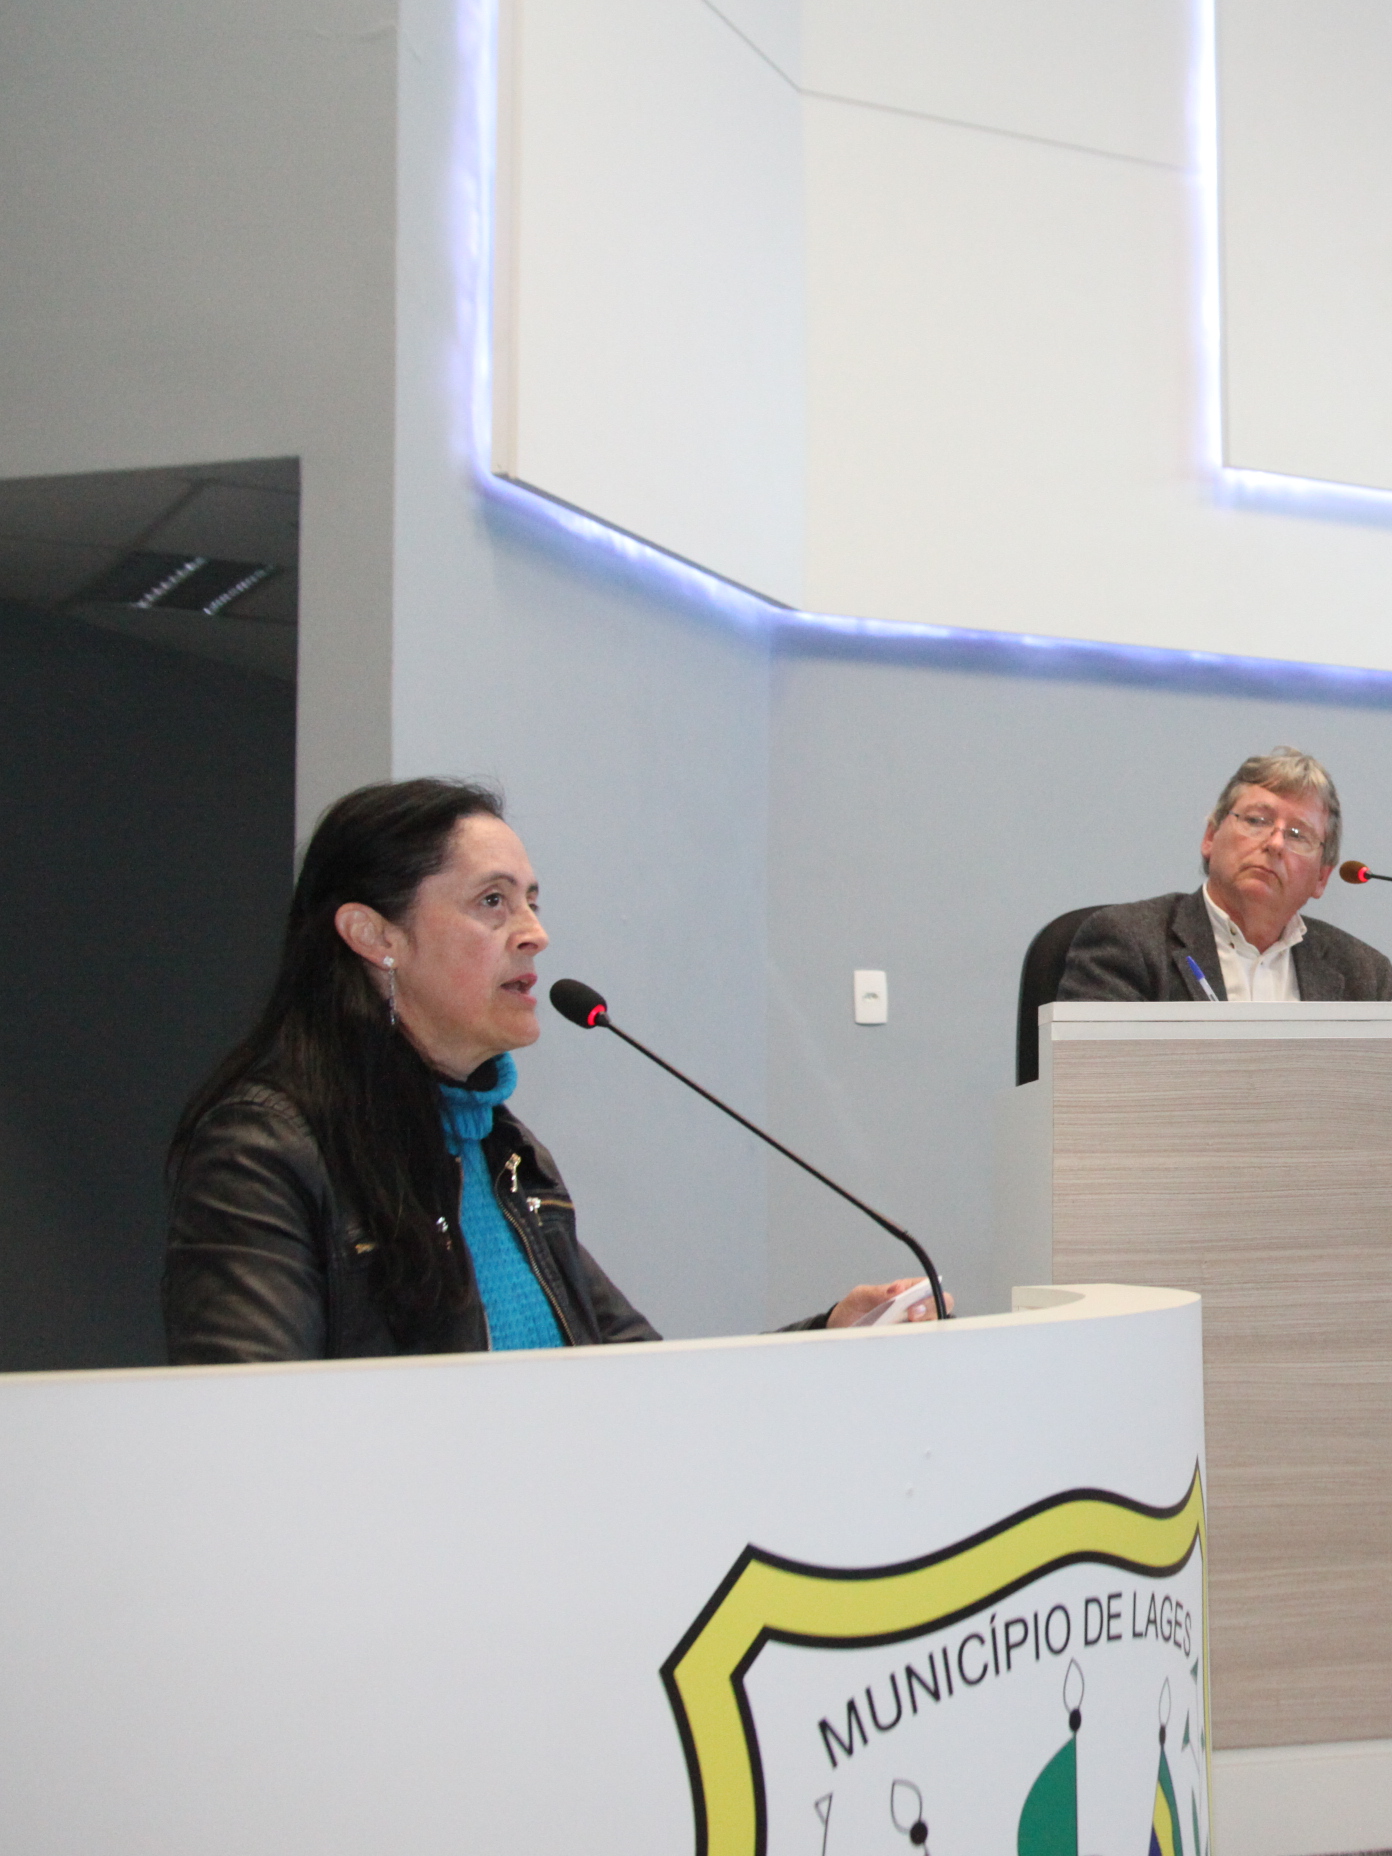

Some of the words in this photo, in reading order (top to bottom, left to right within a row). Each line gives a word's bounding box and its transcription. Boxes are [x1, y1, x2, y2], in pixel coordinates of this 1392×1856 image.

[818, 1603, 1072, 1768] MUNICÍPIO
[1083, 1591, 1123, 1648] DE
[1131, 1590, 1193, 1658] LAGES
